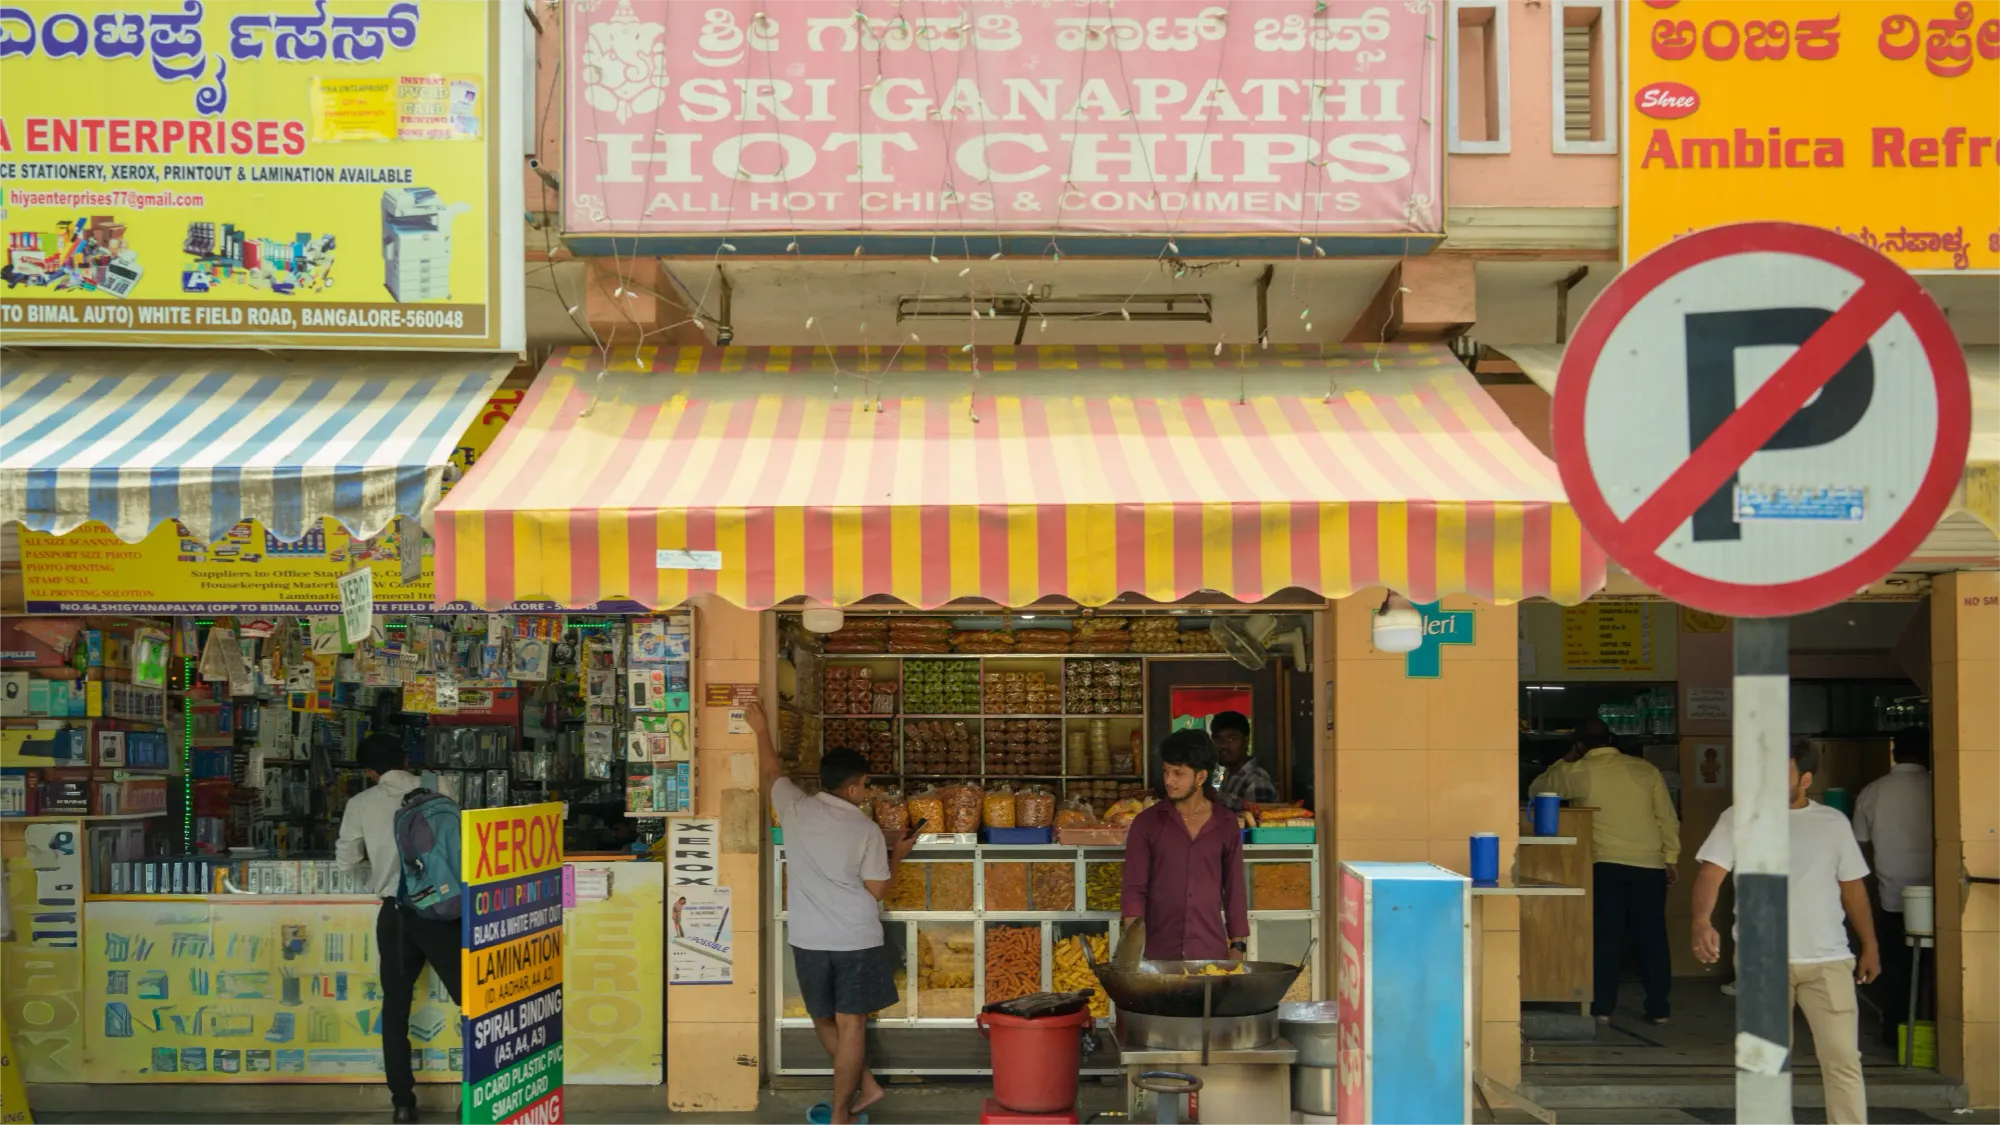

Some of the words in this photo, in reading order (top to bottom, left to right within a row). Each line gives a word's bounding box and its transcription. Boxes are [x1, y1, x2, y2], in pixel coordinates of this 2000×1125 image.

[692, 8, 780, 67] ಶ್ರೀ
[1650, 11, 1842, 62] ಅಂಬಿಕ
[400, 76, 446, 85] INSTANT
[678, 78, 837, 122] SRI
[868, 78, 1405, 123] GANAPATHI
[1640, 88, 1696, 109] Shree
[26, 118, 305, 155] ENTERPRISES
[595, 132, 919, 184] HOT
[954, 132, 1412, 184] CHIPS
[1640, 126, 1845, 169] Ambica
[1870, 126, 2000, 169] Refr
[20, 163, 107, 182] STATIONERY,
[111, 165, 160, 183] XEROX,
[163, 165, 233, 182] PRINTOUT
[236, 167, 247, 182] &
[251, 166, 335, 183] LAMINATION
[339, 168, 413, 184] AVAILABLE
[645, 191, 735, 212] ALL
[750, 191, 843, 212] HOT
[860, 191, 996, 212] CHIPS
[1012, 191, 1042, 212] &
[1057, 191, 1362, 213] CONDIMENTS
[1, 305, 23, 323] TO
[27, 305, 80, 324] BIMAL
[83, 305, 134, 328] AUTO)
[138, 307, 192, 325] WHITE
[196, 307, 244, 325] FIELD
[248, 308, 297, 330] ROAD,
[301, 308, 464, 329] BANGALORE-560048
[1684, 306, 1875, 543] P
[190, 570, 251, 579] Suppliers
[273, 570, 311, 578] Office
[201, 581, 291, 590] Housekeeping
[372, 592, 415, 600] eneral
[207, 604, 239, 613] (OPP
[241, 604, 258, 613] TO
[260, 604, 301, 613] BIMAL
[391, 604, 426, 612] FIELD
[1964, 597, 1980, 606] NO
[1983, 596, 2000, 606] SM
[1422, 614, 1457, 637] leri
[475, 813, 561, 879] XEROX
[674, 823, 714, 886] XEROX
[475, 887, 515, 916] COLOUR
[516, 879, 543, 907] PRINT
[543, 875, 561, 900] OUT
[474, 920, 500, 946] BLACK
[500, 918, 506, 938] &
[507, 912, 529, 936] WHITE
[530, 907, 548, 928] PRINT
[549, 903, 562, 925] OUT
[475, 934, 561, 987] LAMINATION
[564, 893, 642, 1076] EROX
[474, 1008, 518, 1050] SPIRAL
[519, 988, 562, 1031] BINDING
[495, 1043, 514, 1069] (A5,
[515, 1035, 530, 1056] A4,
[531, 1025, 547, 1047] A3)
[473, 1086, 484, 1108] ID
[485, 1072, 511, 1101] CARD
[512, 1056, 546, 1088] PLASTIC
[547, 1044, 564, 1069] PVC
[491, 1087, 523, 1122] SMART
[525, 1075, 549, 1102] CARD
